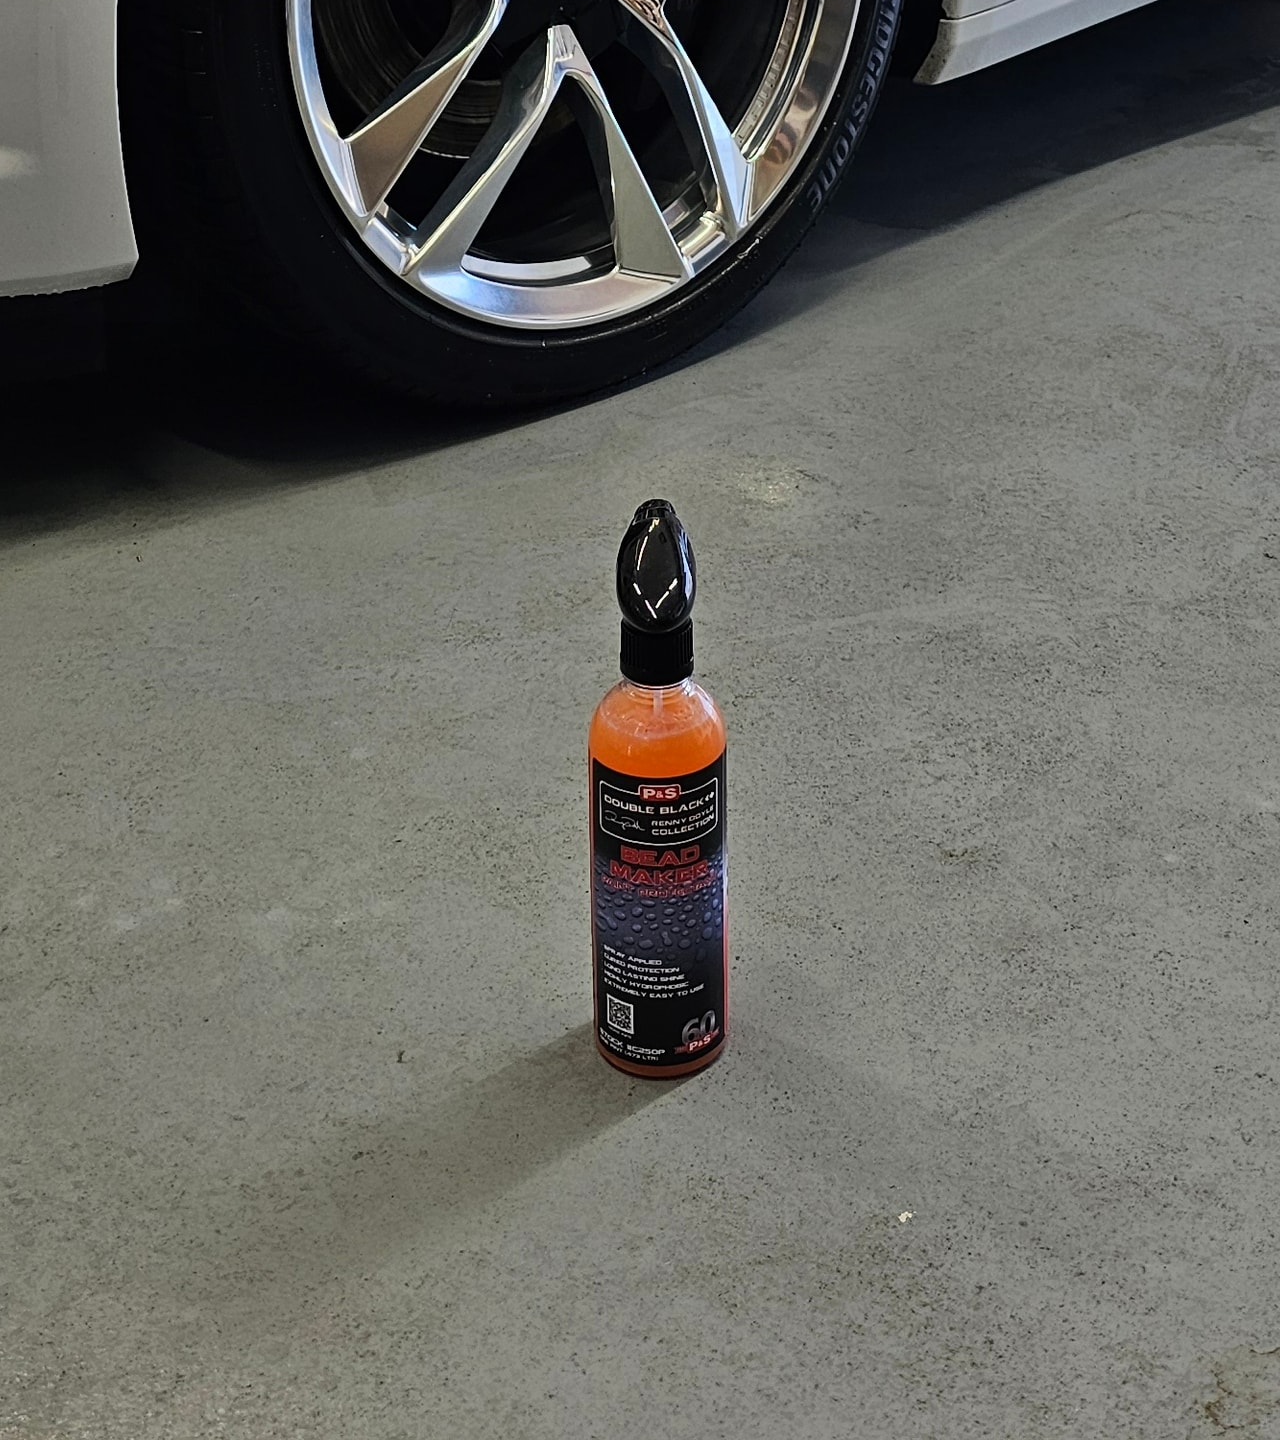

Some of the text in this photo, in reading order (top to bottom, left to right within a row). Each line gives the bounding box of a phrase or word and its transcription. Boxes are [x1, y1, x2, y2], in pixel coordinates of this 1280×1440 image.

[604, 794, 704, 815] DOUBLE BLACK
[643, 788, 677, 800] P&S
[651, 818, 686, 827] RENNY
[688, 804, 714, 822] DOYLE
[651, 812, 715, 836] COLLECTION
[620, 845, 700, 866] BEAD
[609, 860, 709, 886] MAKER
[622, 970, 658, 982] LASTING
[627, 963, 681, 974] PROTECTION
[682, 1010, 716, 1046] 60
[689, 1034, 712, 1052] P&S
